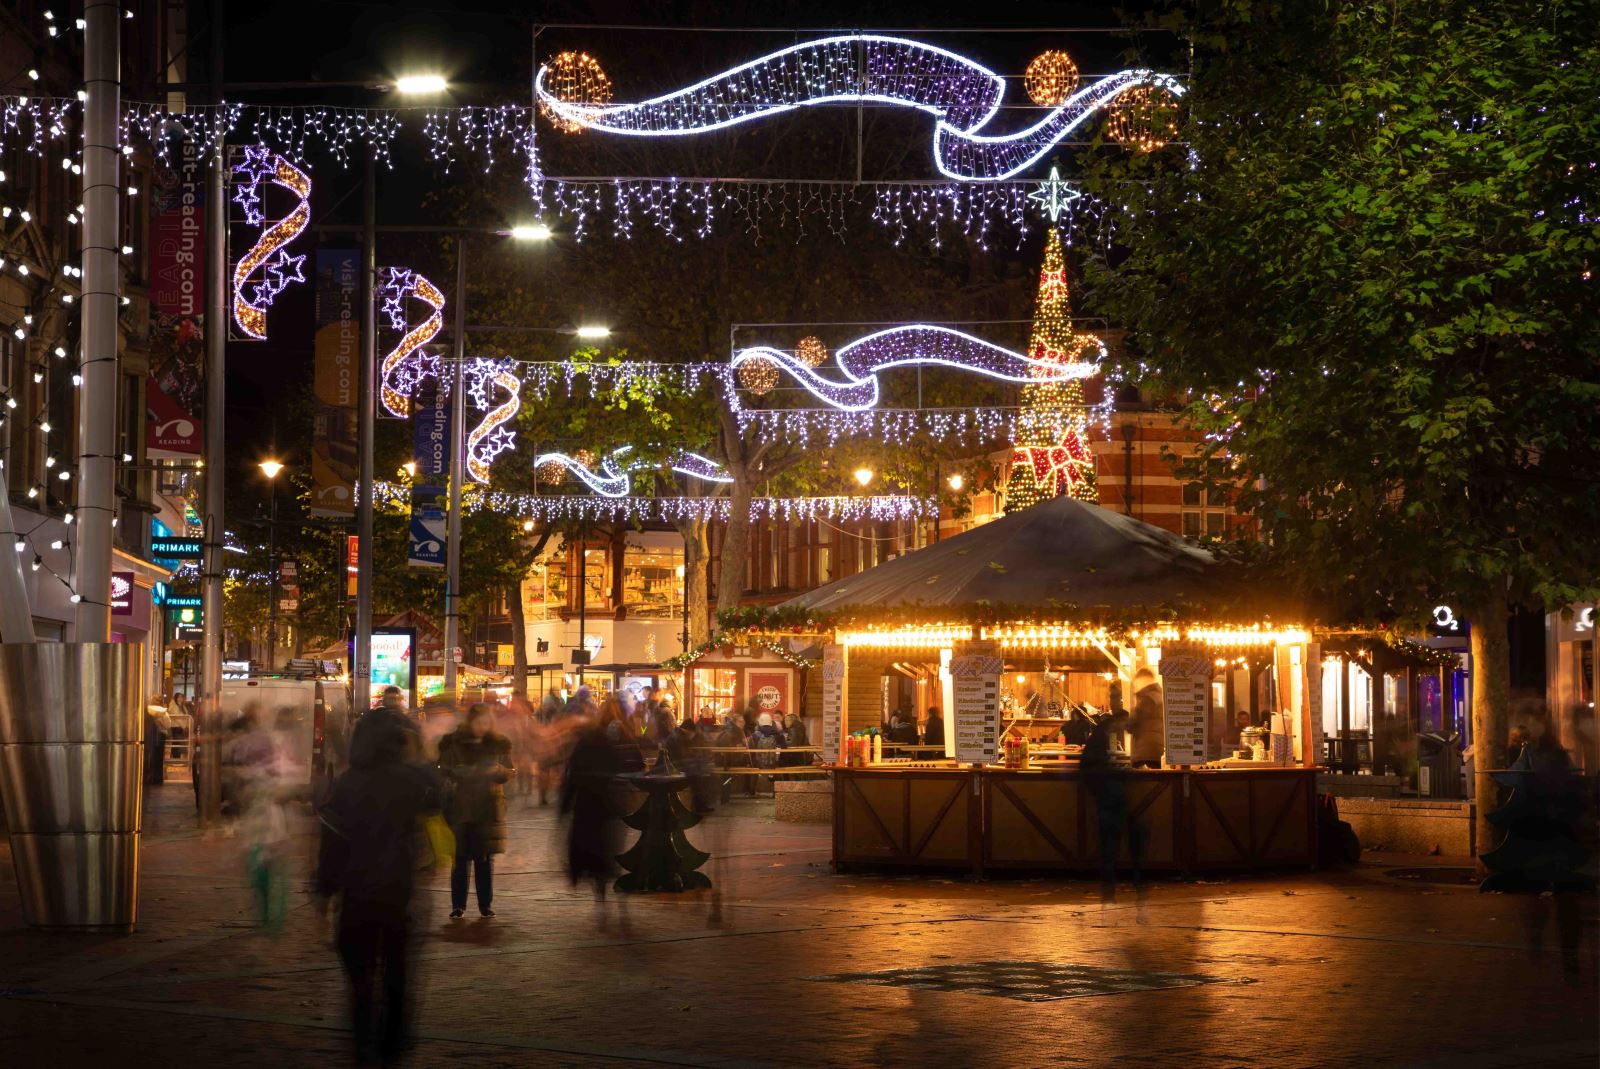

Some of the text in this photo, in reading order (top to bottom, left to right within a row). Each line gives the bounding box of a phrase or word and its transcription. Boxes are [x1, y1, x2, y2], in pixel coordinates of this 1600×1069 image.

[176, 132, 199, 315] isit-reading.com
[336, 259, 355, 404] visit-reading.com
[152, 543, 199, 552] PRIMARK
